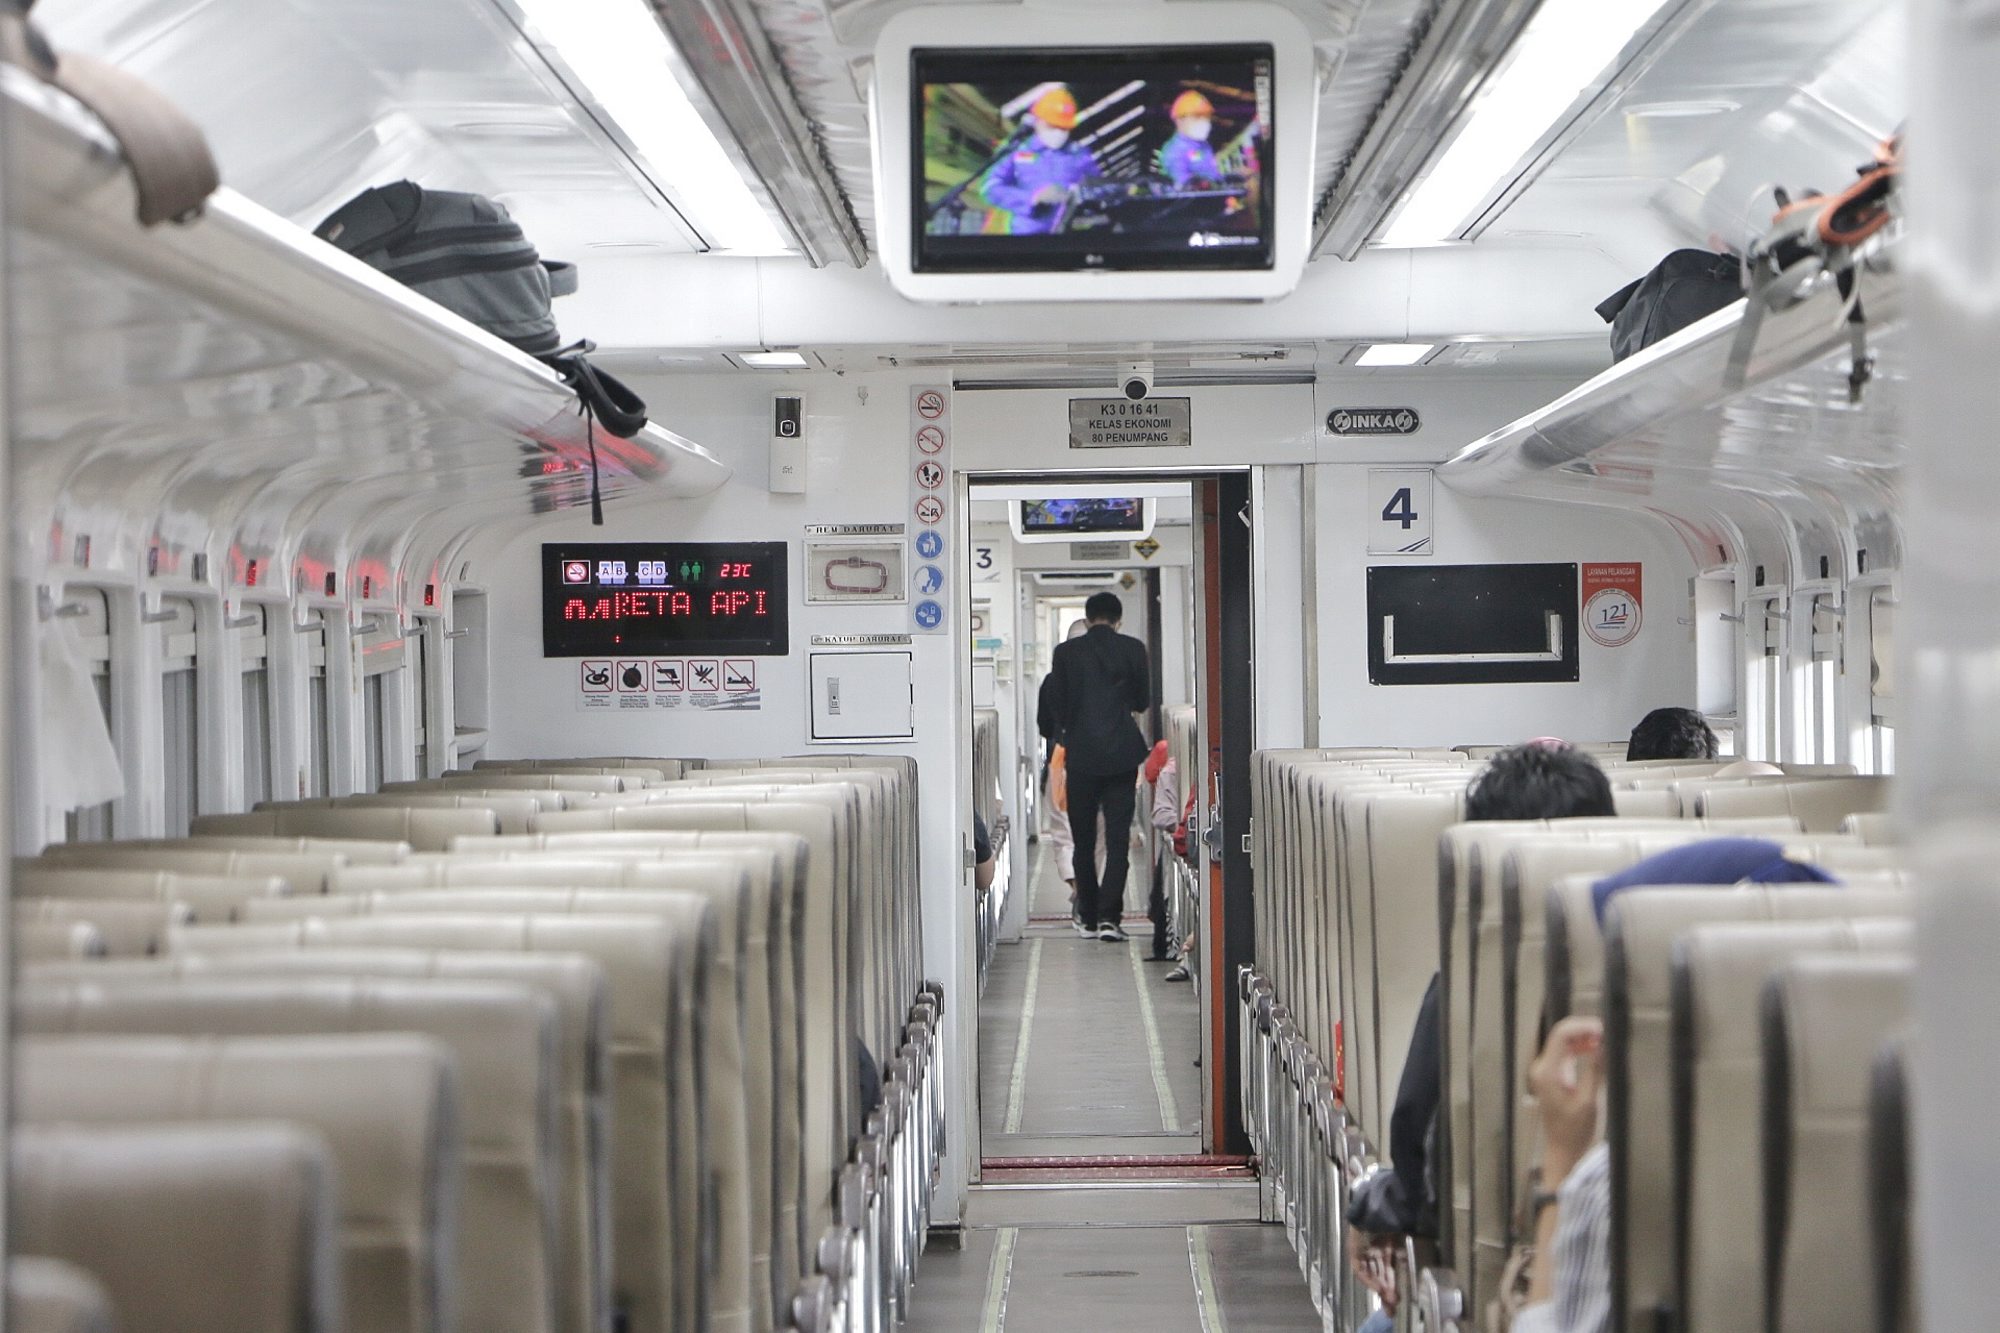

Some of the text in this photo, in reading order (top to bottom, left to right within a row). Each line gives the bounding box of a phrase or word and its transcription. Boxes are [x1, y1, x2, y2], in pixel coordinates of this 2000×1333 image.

[1101, 404, 1158, 415] K3 0 16 41
[1089, 418, 1172, 429] KELAS EKONOMI
[1352, 415, 1395, 428] INKA
[1092, 432, 1169, 443] 80 PENUMPANG
[1382, 487, 1418, 529] 4
[976, 548, 992, 569] 3
[602, 567, 663, 576] A B C D
[711, 590, 767, 615] API
[1602, 603, 1627, 622] 121
